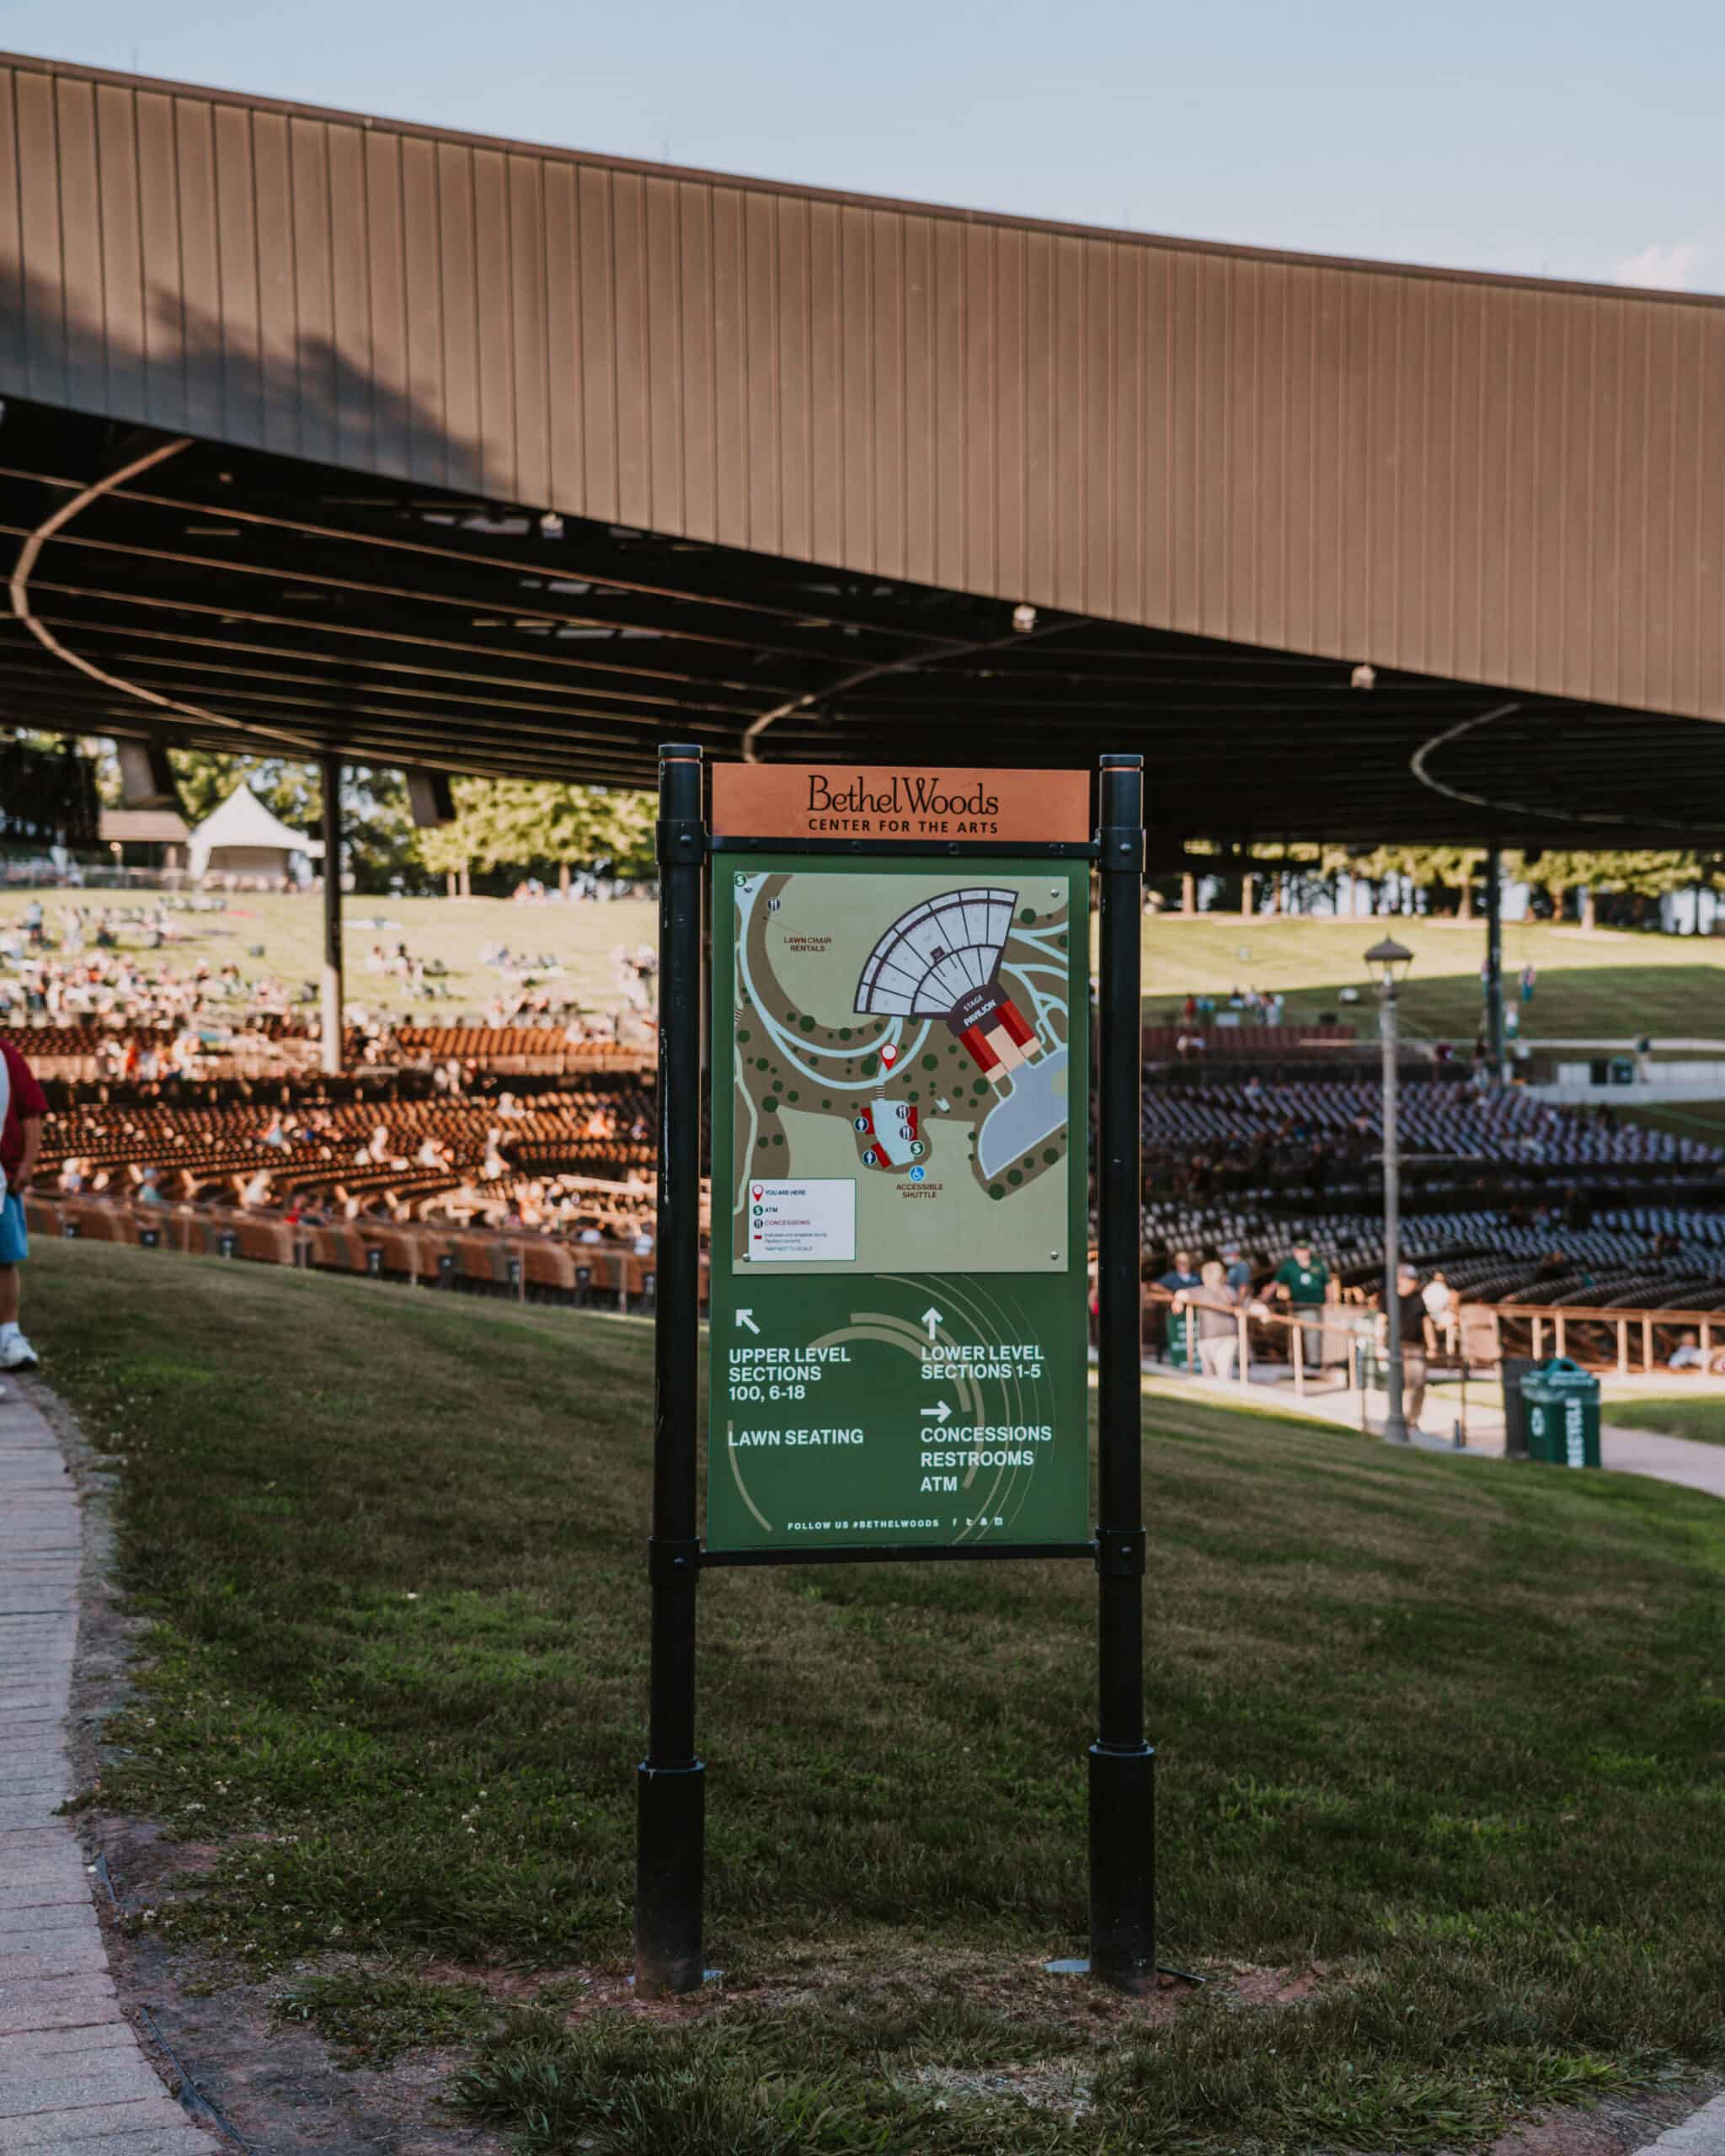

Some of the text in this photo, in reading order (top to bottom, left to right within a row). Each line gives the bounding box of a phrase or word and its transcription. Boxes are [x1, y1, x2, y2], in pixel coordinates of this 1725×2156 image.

[809, 819, 997, 833] CENTER FOR THE ARTS
[964, 999, 997, 1027] PAVILION
[730, 1348, 850, 1364] UPPER LEVEL
[921, 1346, 1044, 1361] LOWER LEVEL
[729, 1366, 820, 1382] SECTIONS
[921, 1364, 1040, 1379] SECTIONS 1-5
[729, 1385, 804, 1402] 100, 6-18
[729, 1429, 862, 1446] LAWN SEATING
[921, 1427, 1051, 1442] CONCESSIONS
[921, 1451, 1033, 1466] RESTROOMS
[921, 1477, 957, 1491] ATM
[788, 1522, 831, 1530] FOLLOW
[852, 1519, 939, 1529] #BETHELWOODS
